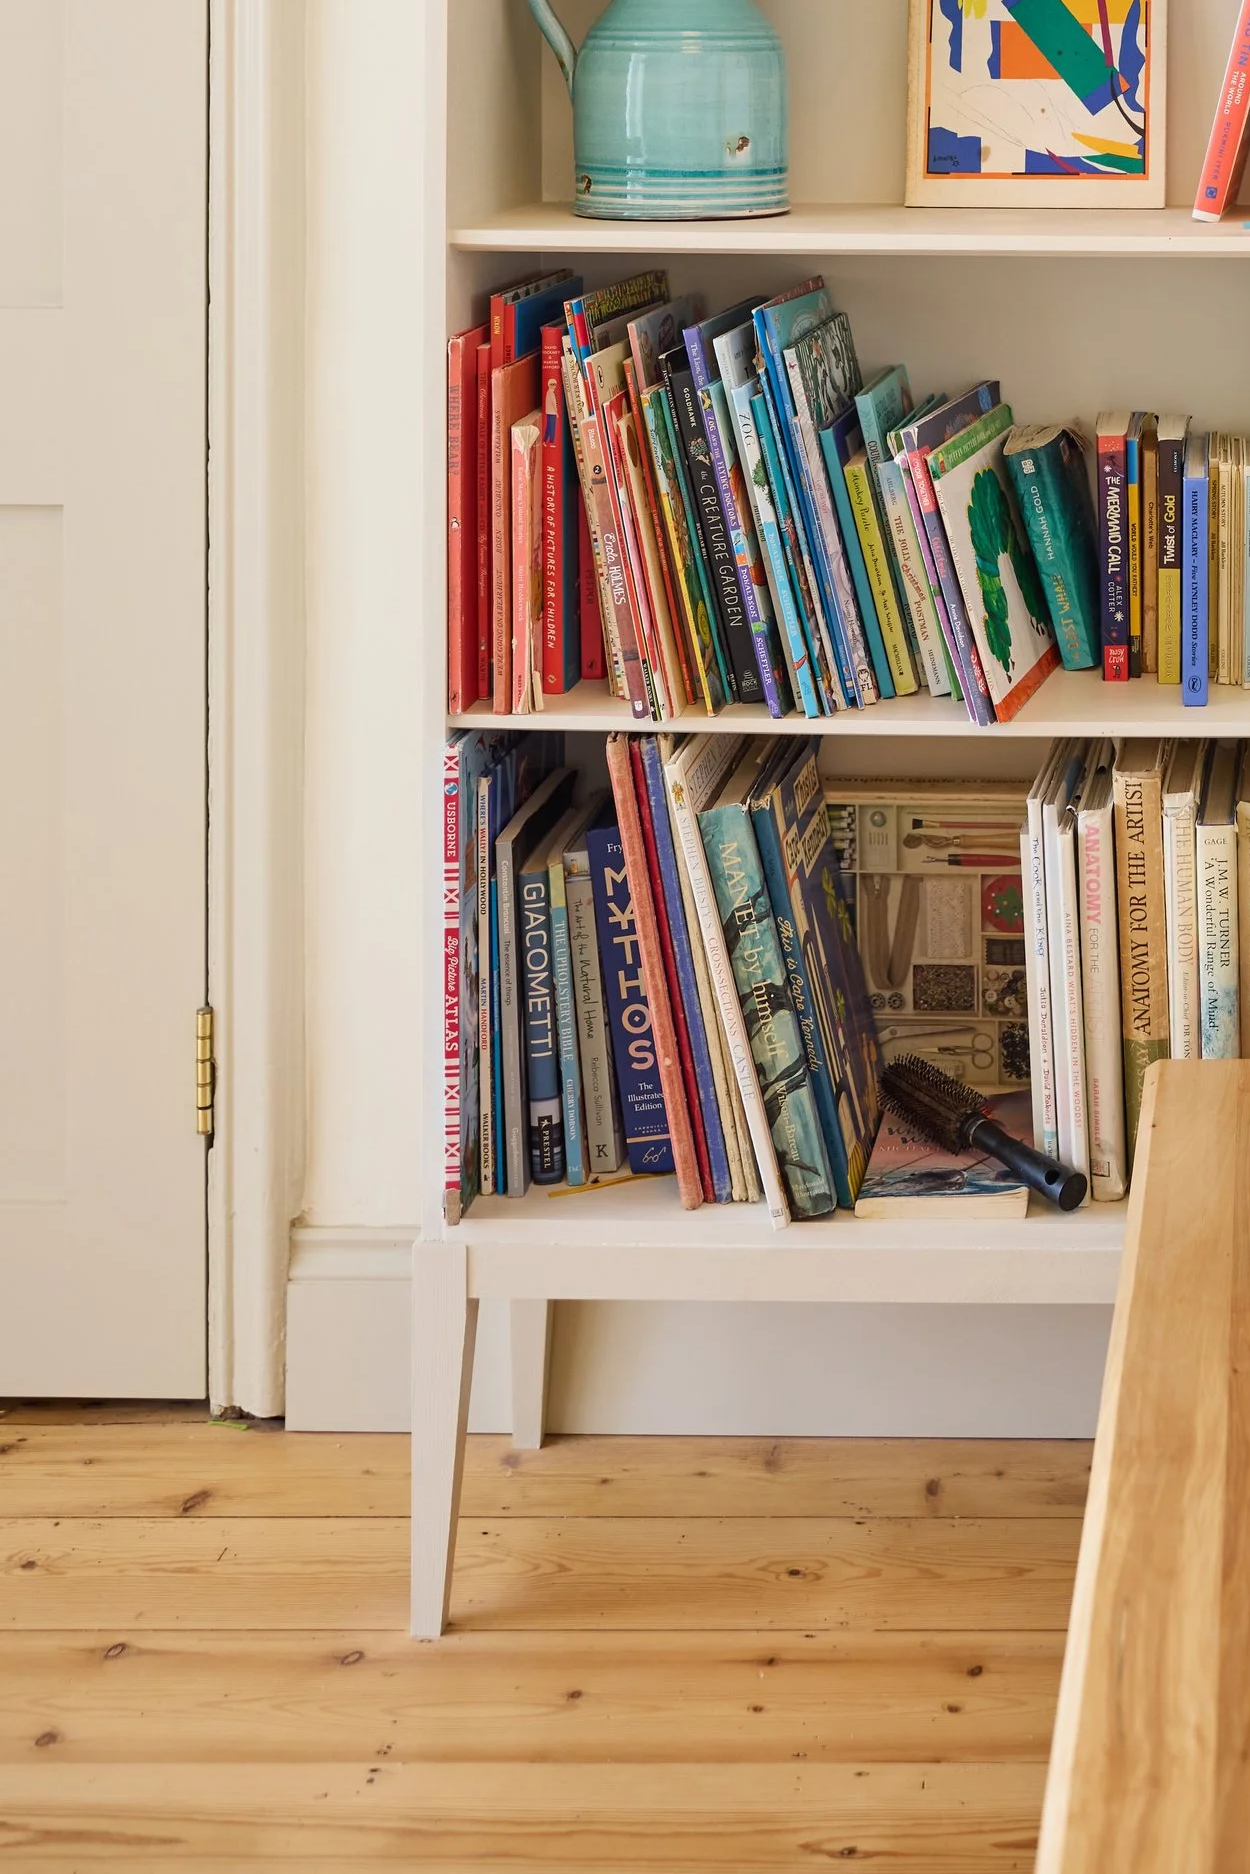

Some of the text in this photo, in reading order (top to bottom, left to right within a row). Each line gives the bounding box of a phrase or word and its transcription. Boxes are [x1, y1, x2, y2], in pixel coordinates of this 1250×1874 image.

[547, 473, 556, 513] HISTORY
[1104, 476, 1121, 486] THE
[547, 516, 556, 528] OF
[1106, 487, 1123, 575] MERMAID CALL
[1163, 494, 1176, 564] Twist of Gold
[546, 533, 556, 576] PICTURES
[701, 485, 742, 627] CREATURE GARDEN
[546, 581, 556, 598] FOR
[546, 600, 556, 650] CHILDREN
[445, 802, 456, 857] USBORNE
[1204, 837, 1227, 846] GAGE
[1126, 780, 1152, 1034] ANATOMY FOR THE ARTIST
[523, 883, 553, 1058] GIACOMETTI
[719, 842, 789, 1059] MANET by himself
[444, 935, 459, 1051] Big Picture ATLAS
[540, 1130, 551, 1169] PRESTEL
